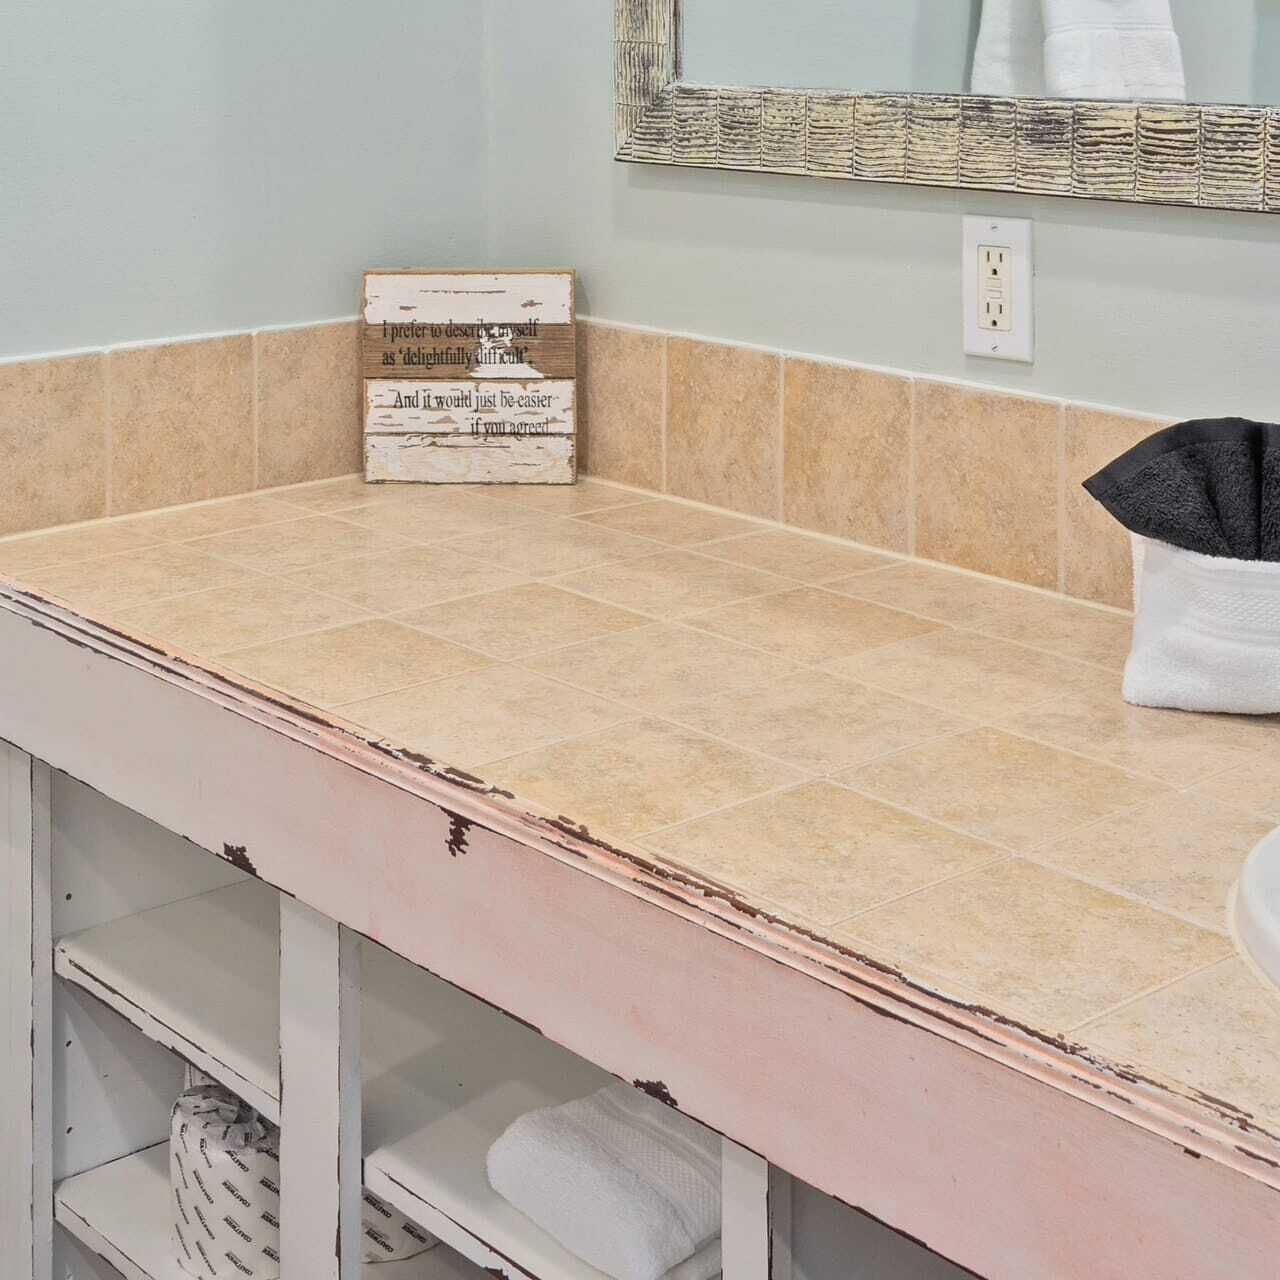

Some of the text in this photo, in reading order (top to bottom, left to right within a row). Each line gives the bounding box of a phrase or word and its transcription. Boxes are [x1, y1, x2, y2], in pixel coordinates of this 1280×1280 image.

[391, 319, 426, 342] prefer
[431, 322, 442, 338] to
[382, 352, 396, 366] as
[393, 390, 553, 413] And it would just be easier
[471, 417, 549, 442] if you agreed
